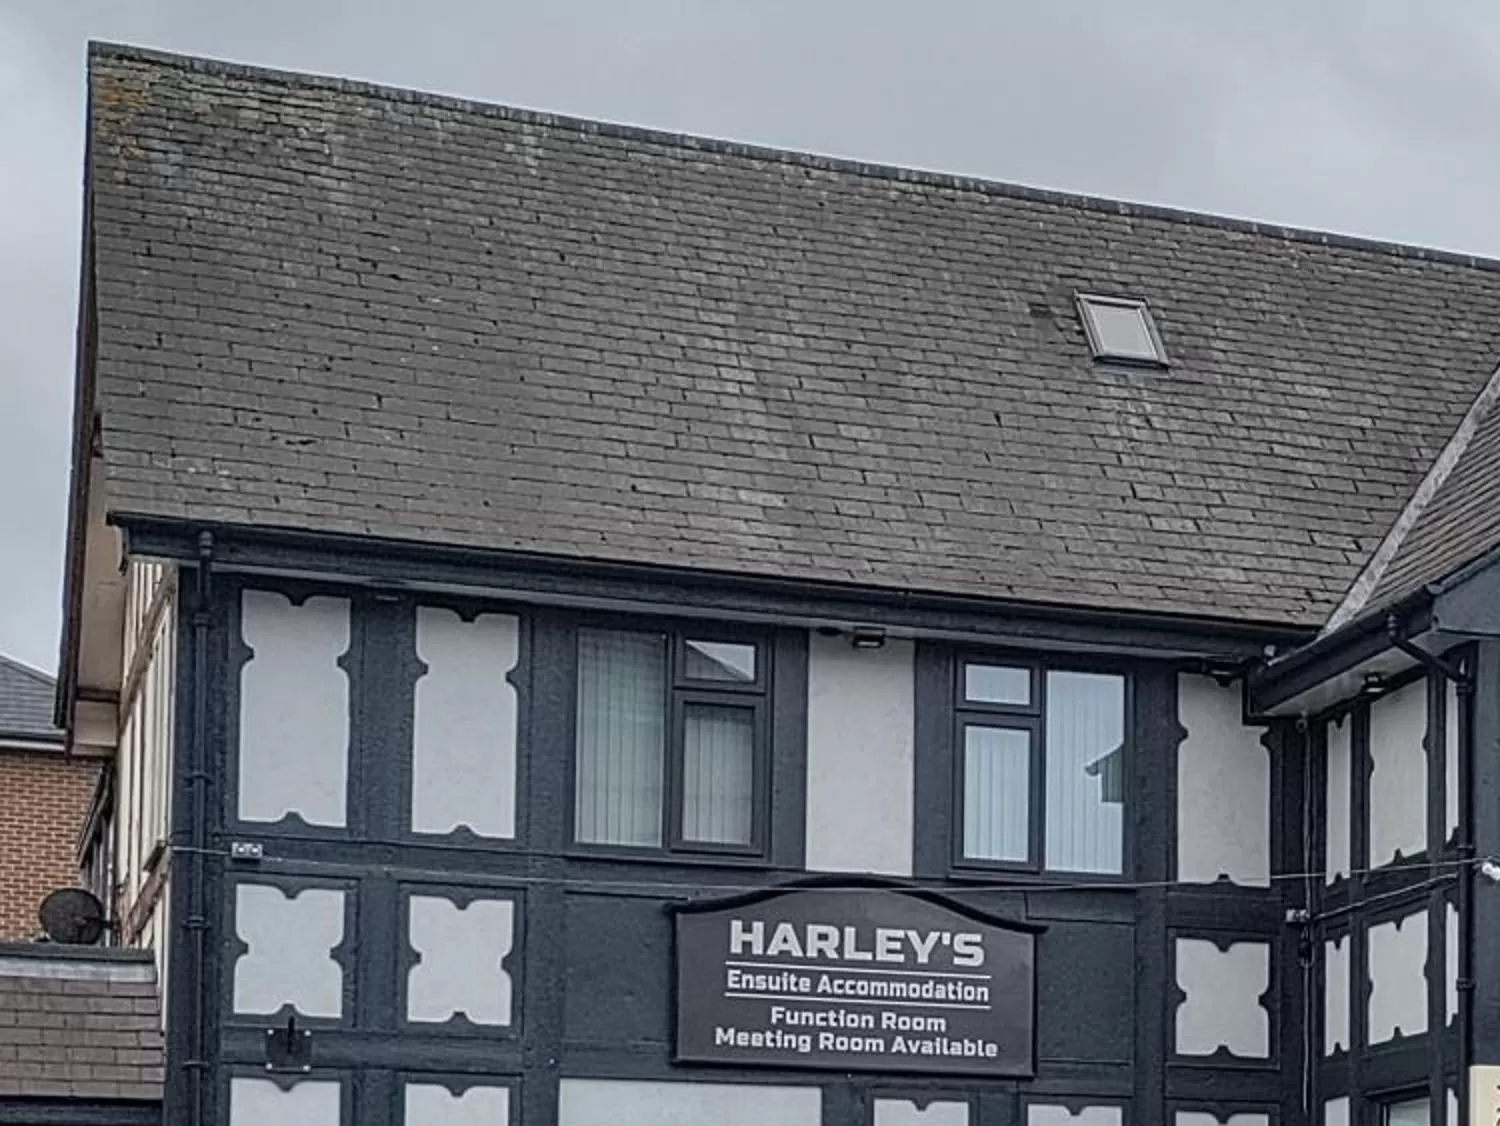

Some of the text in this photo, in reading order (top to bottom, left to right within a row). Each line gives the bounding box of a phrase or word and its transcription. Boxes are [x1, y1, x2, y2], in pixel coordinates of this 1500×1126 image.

[731, 919, 985, 967] HARLEY'S
[727, 969, 989, 1002] Ensuite Accommodation
[771, 1006, 946, 1032] Function Room
[715, 1027, 998, 1058] Meeting Room Available
